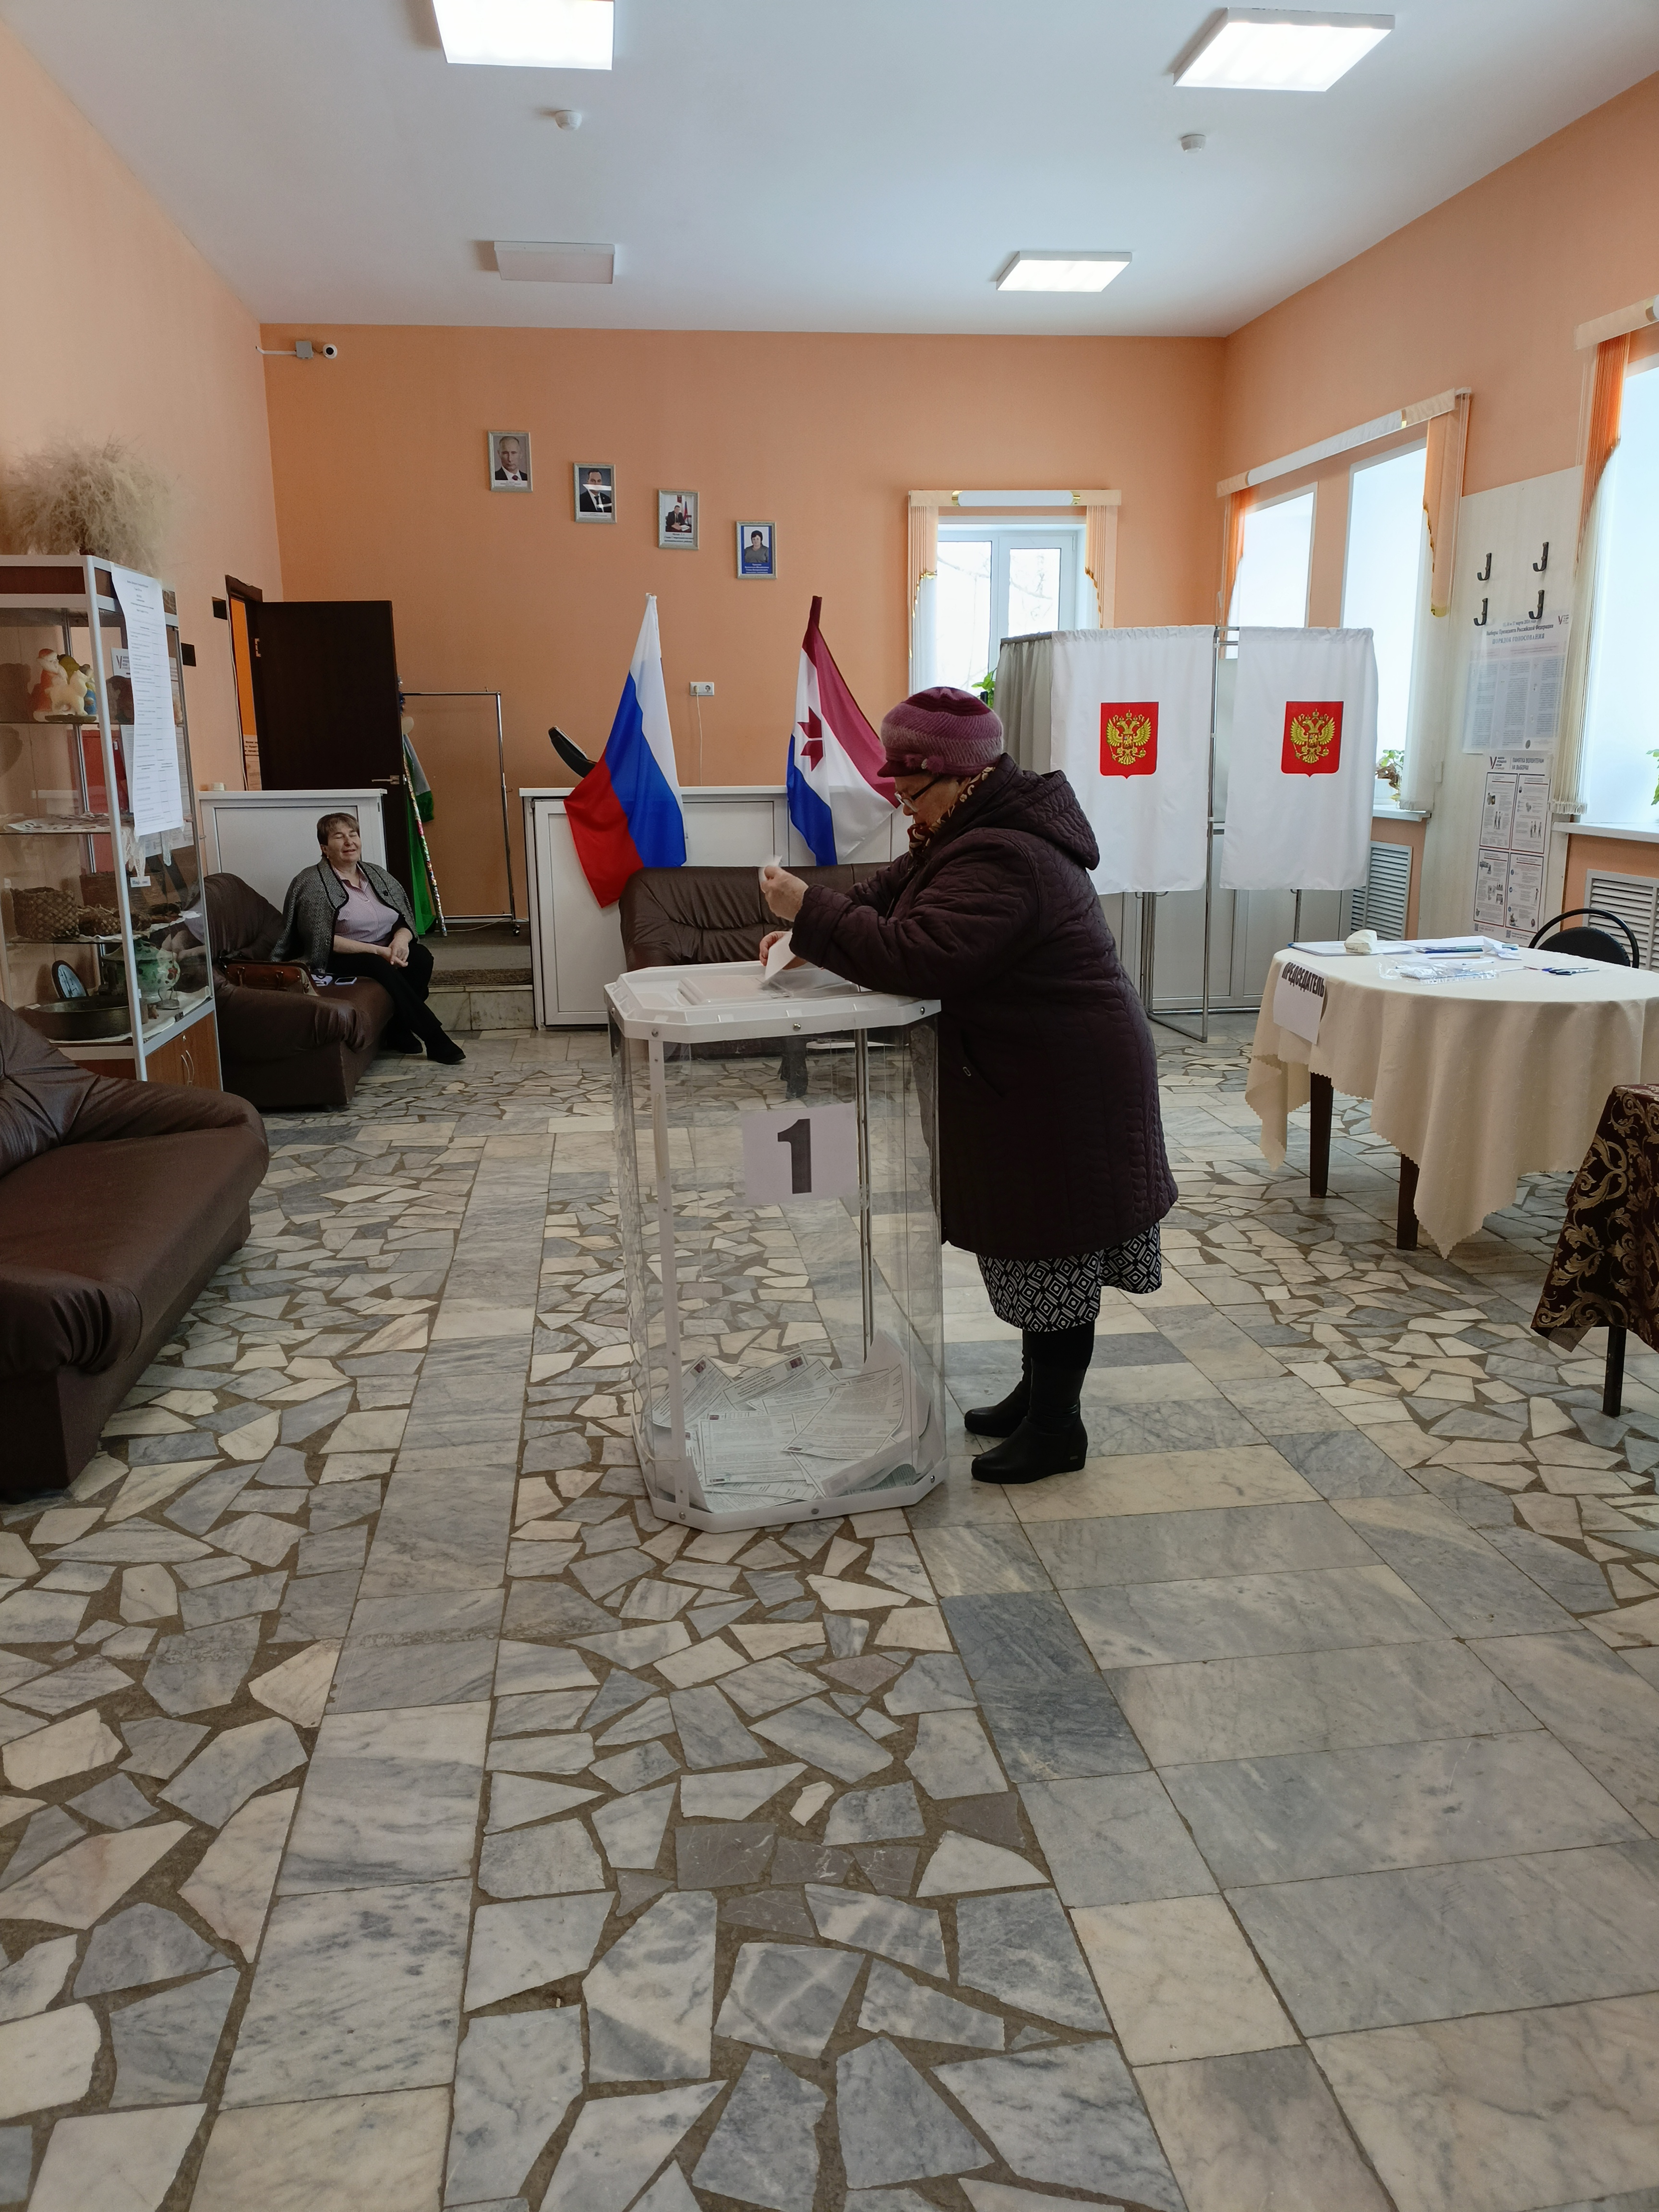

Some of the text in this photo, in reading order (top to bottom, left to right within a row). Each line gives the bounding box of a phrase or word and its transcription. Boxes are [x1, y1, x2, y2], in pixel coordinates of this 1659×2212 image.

[1512, 633, 1545, 642] ГОЛОСОВАНИЯ
[1281, 962, 1325, 998] ПРЕДСЕДАТЕЛЬ
[777, 1118, 812, 1194] 1
